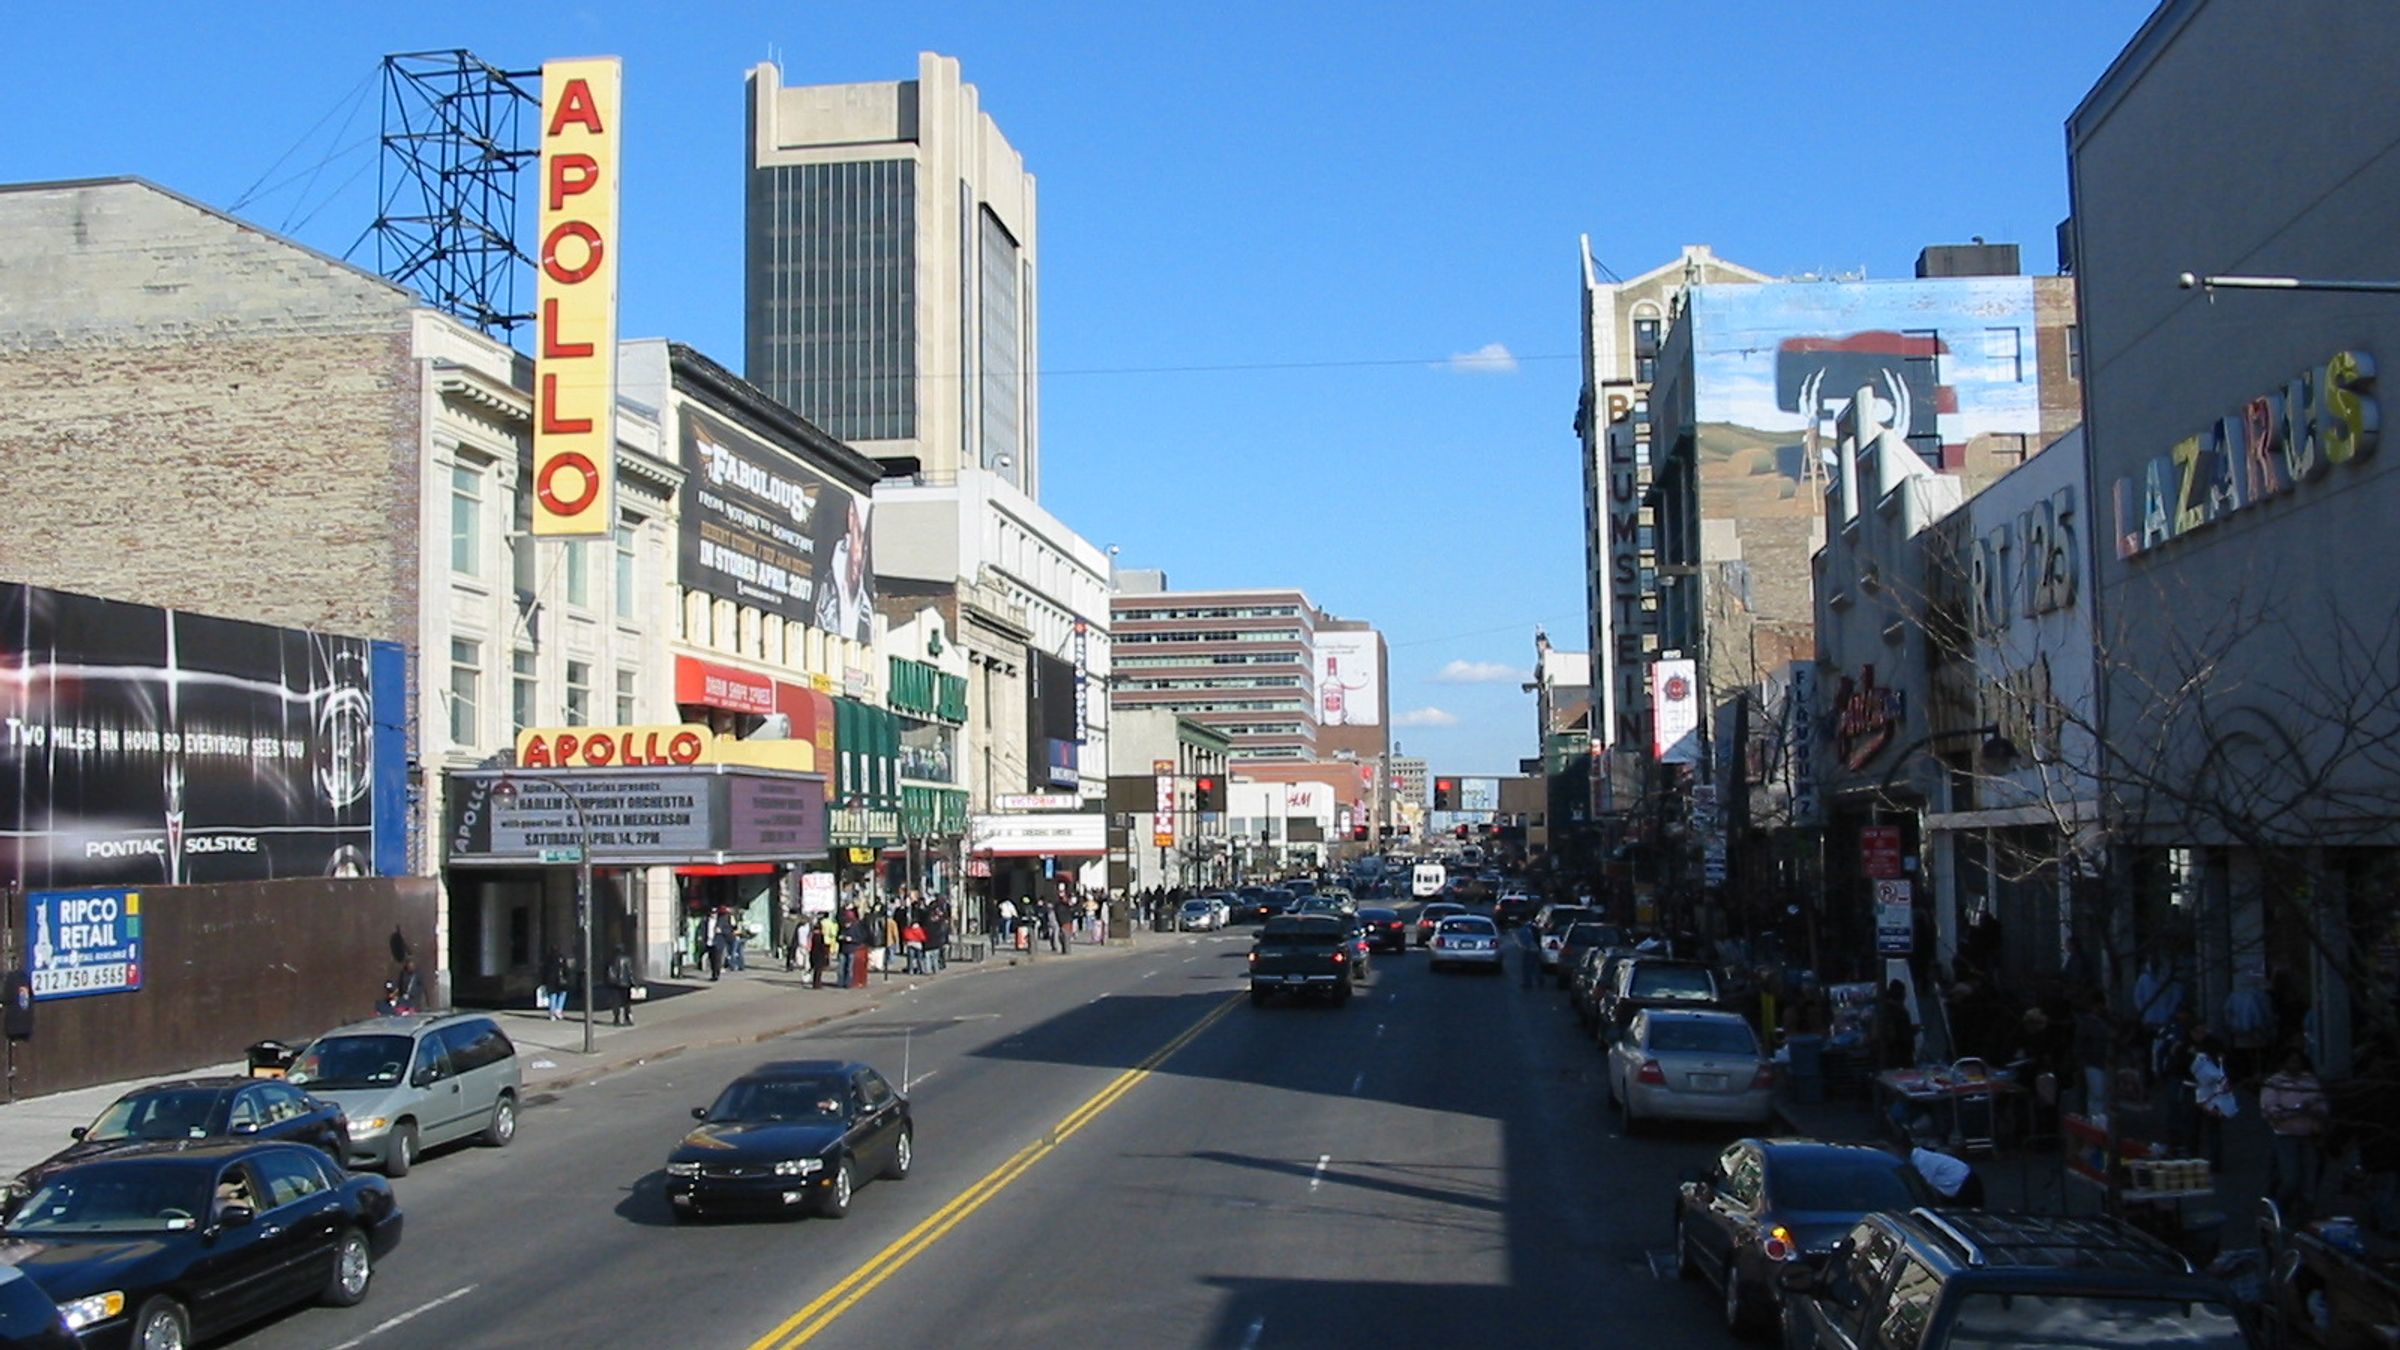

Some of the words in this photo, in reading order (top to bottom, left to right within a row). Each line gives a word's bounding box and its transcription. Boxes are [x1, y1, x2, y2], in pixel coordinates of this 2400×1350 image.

[537, 78, 604, 517] APOLLO
[2113, 351, 2378, 560] LAZARUS
[710, 443, 808, 523] FABOLOUS
[700, 539, 714, 567] IN
[715, 547, 756, 583] STORES
[757, 561, 787, 594] APRIL
[2017, 485, 2079, 619] 125
[1608, 394, 1641, 743] BLUMSTEIN
[51, 726, 97, 750] MILES
[124, 730, 160, 751] HOUR
[163, 733, 181, 753] SO
[185, 734, 248, 756] EVERYBODY
[252, 738, 279, 757] SEES
[282, 740, 304, 758] YOU
[523, 732, 702, 767] APOLLO
[518, 797, 562, 810] HARLEM
[628, 796, 694, 809] ORCHESTRA
[623, 814, 690, 827] MERKERSON
[85, 838, 165, 858] PONTIAC
[185, 836, 257, 853] SOLSTICE
[637, 831, 660, 845] 2PM
[60, 897, 117, 924] RIPCO
[60, 924, 117, 950] RETAIL
[35, 965, 124, 991] 212.750.6565
